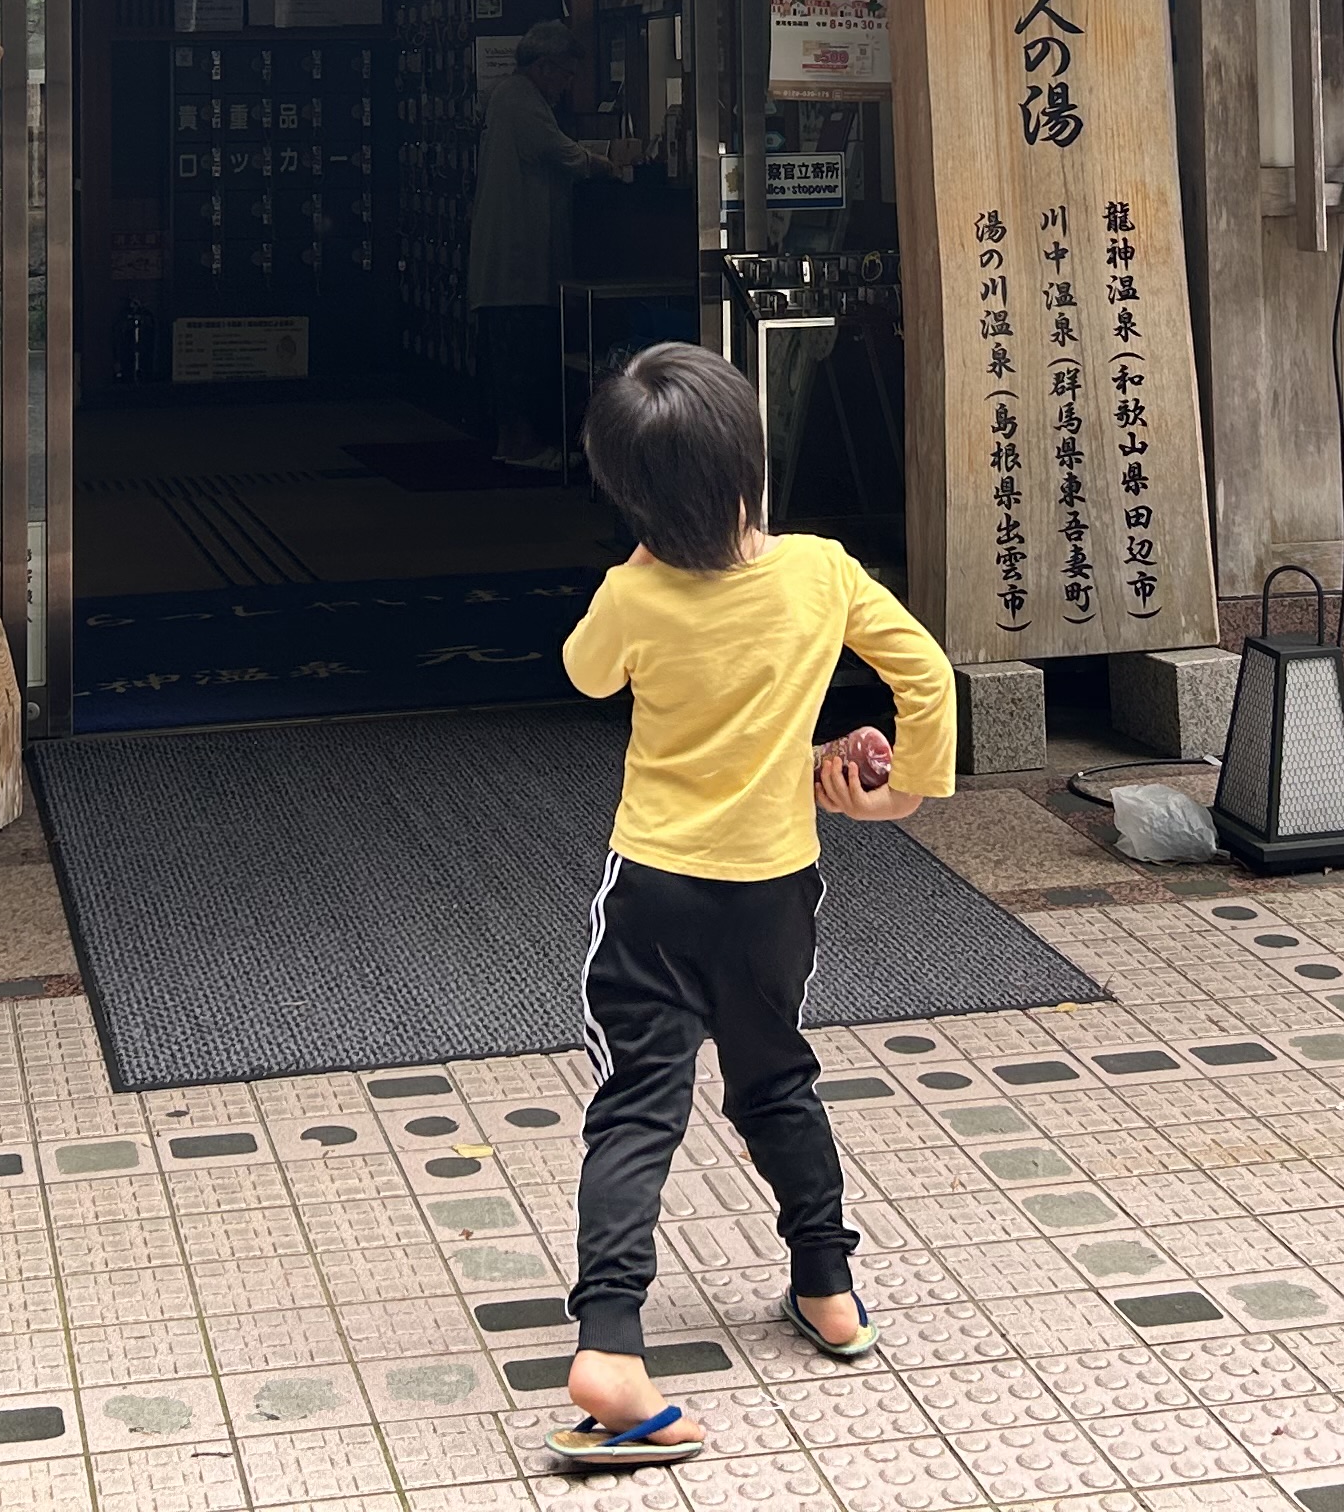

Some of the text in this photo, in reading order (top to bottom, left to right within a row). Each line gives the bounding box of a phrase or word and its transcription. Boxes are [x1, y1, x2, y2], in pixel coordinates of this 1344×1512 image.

[178, 103, 298, 131] 貴重品
[767, 162, 840, 181] 察官立寄所
[974, 210, 1033, 633] 湯の川温泉(島根県出雲市)
[1040, 204, 1097, 625] 川中温泉(群馬県東吾妻町)
[1102, 201, 1163, 619] 龍神温泉(和歌山県田辺市)
